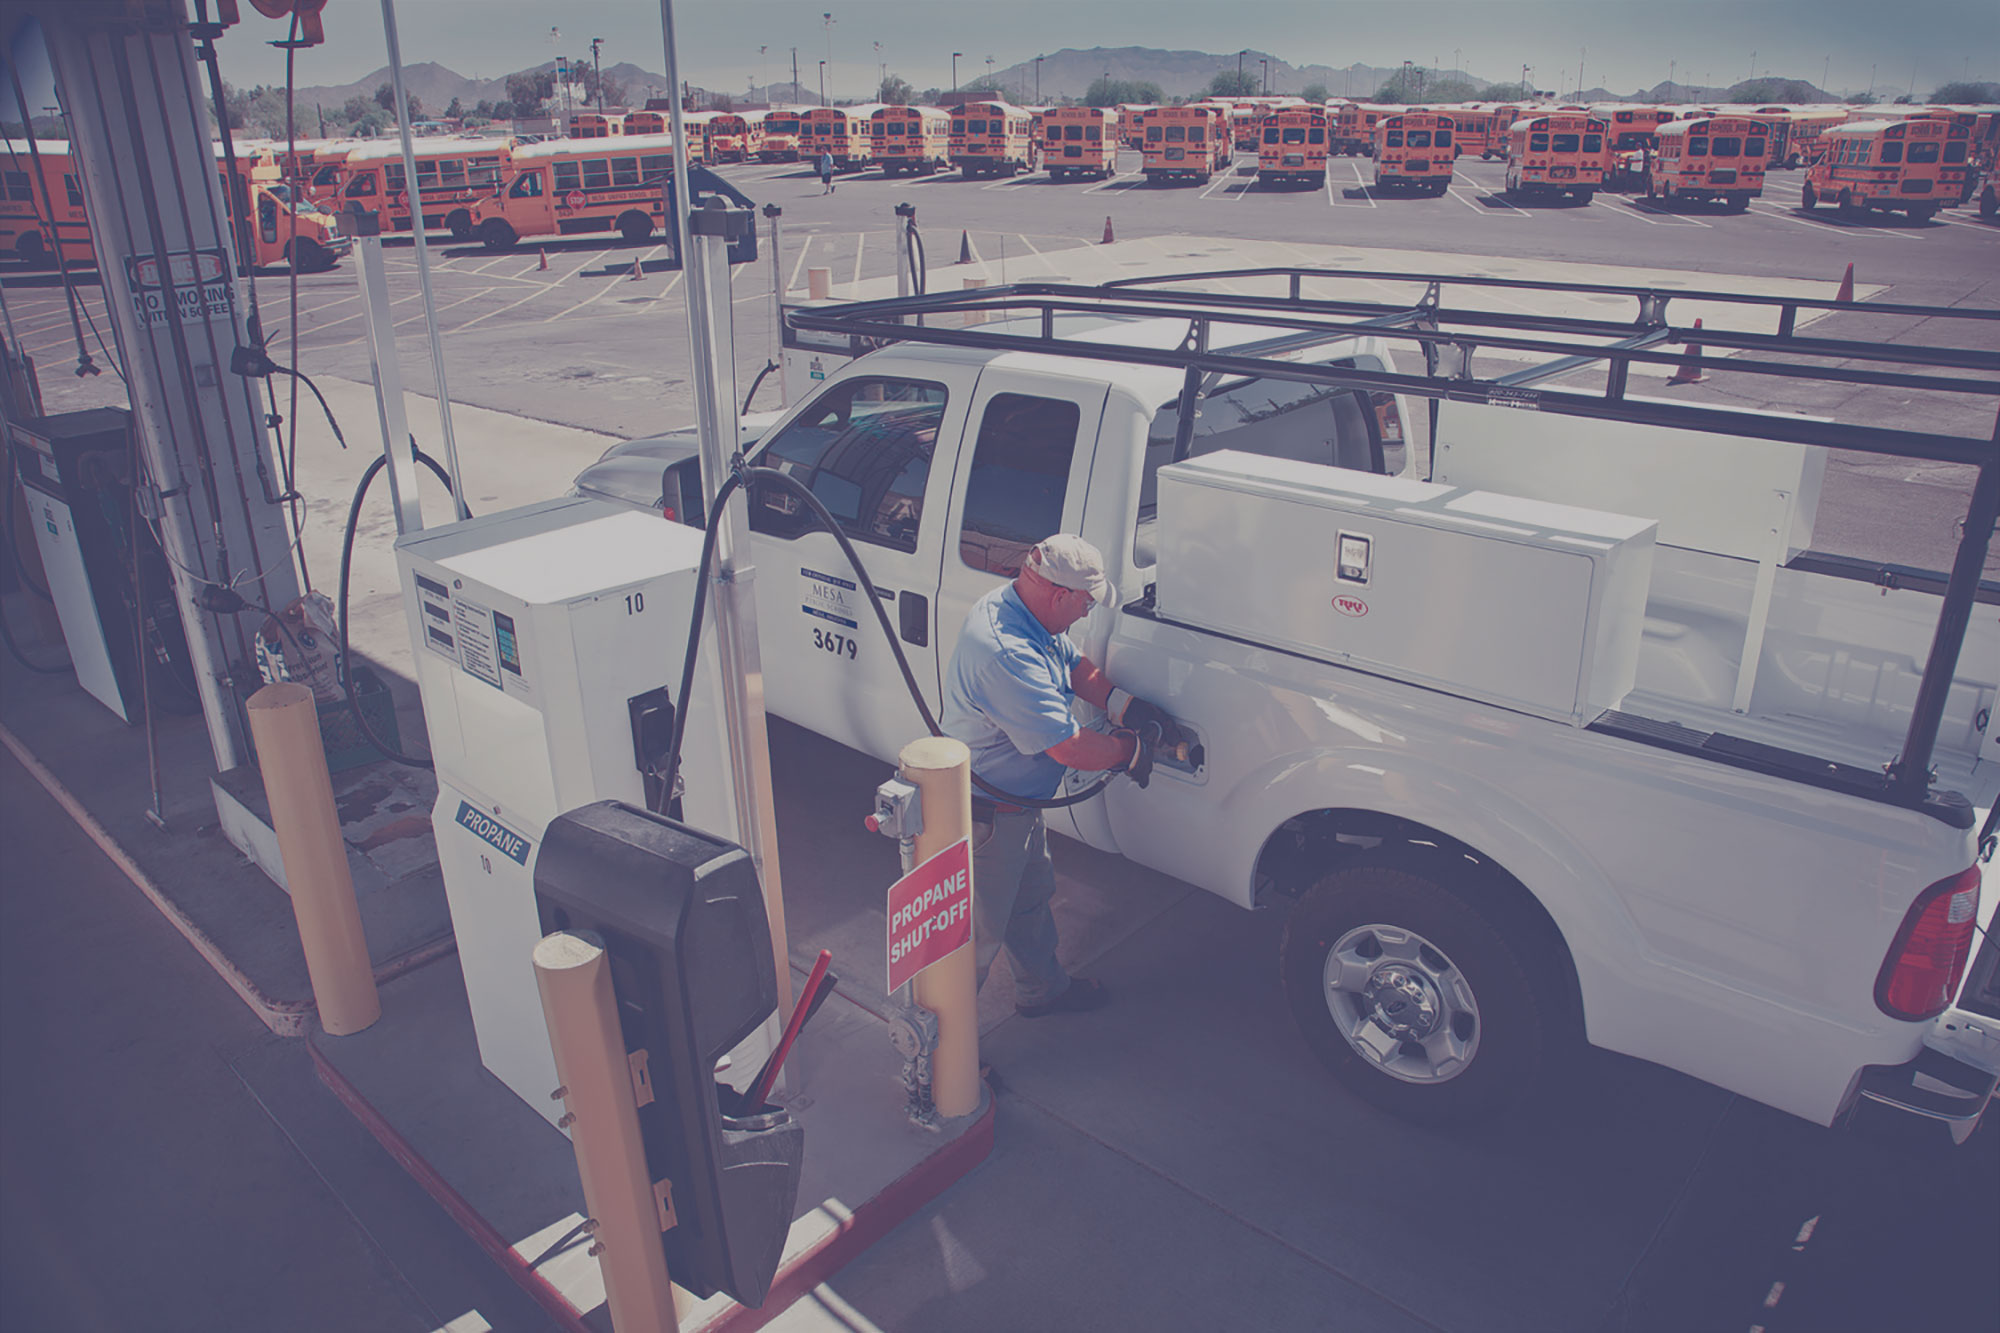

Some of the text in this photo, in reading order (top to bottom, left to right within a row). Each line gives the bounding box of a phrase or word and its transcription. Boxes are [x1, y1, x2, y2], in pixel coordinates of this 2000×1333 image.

[570, 196, 584, 205] STOP
[134, 286, 236, 311] NO MOKING
[625, 592, 645, 616] 10
[812, 584, 844, 604] MESA
[813, 628, 857, 660] 3679
[463, 808, 523, 857] PROPANE
[480, 854, 492, 874] 10
[892, 868, 966, 935] PROPANE
[891, 897, 968, 964] SHUT-OFF
